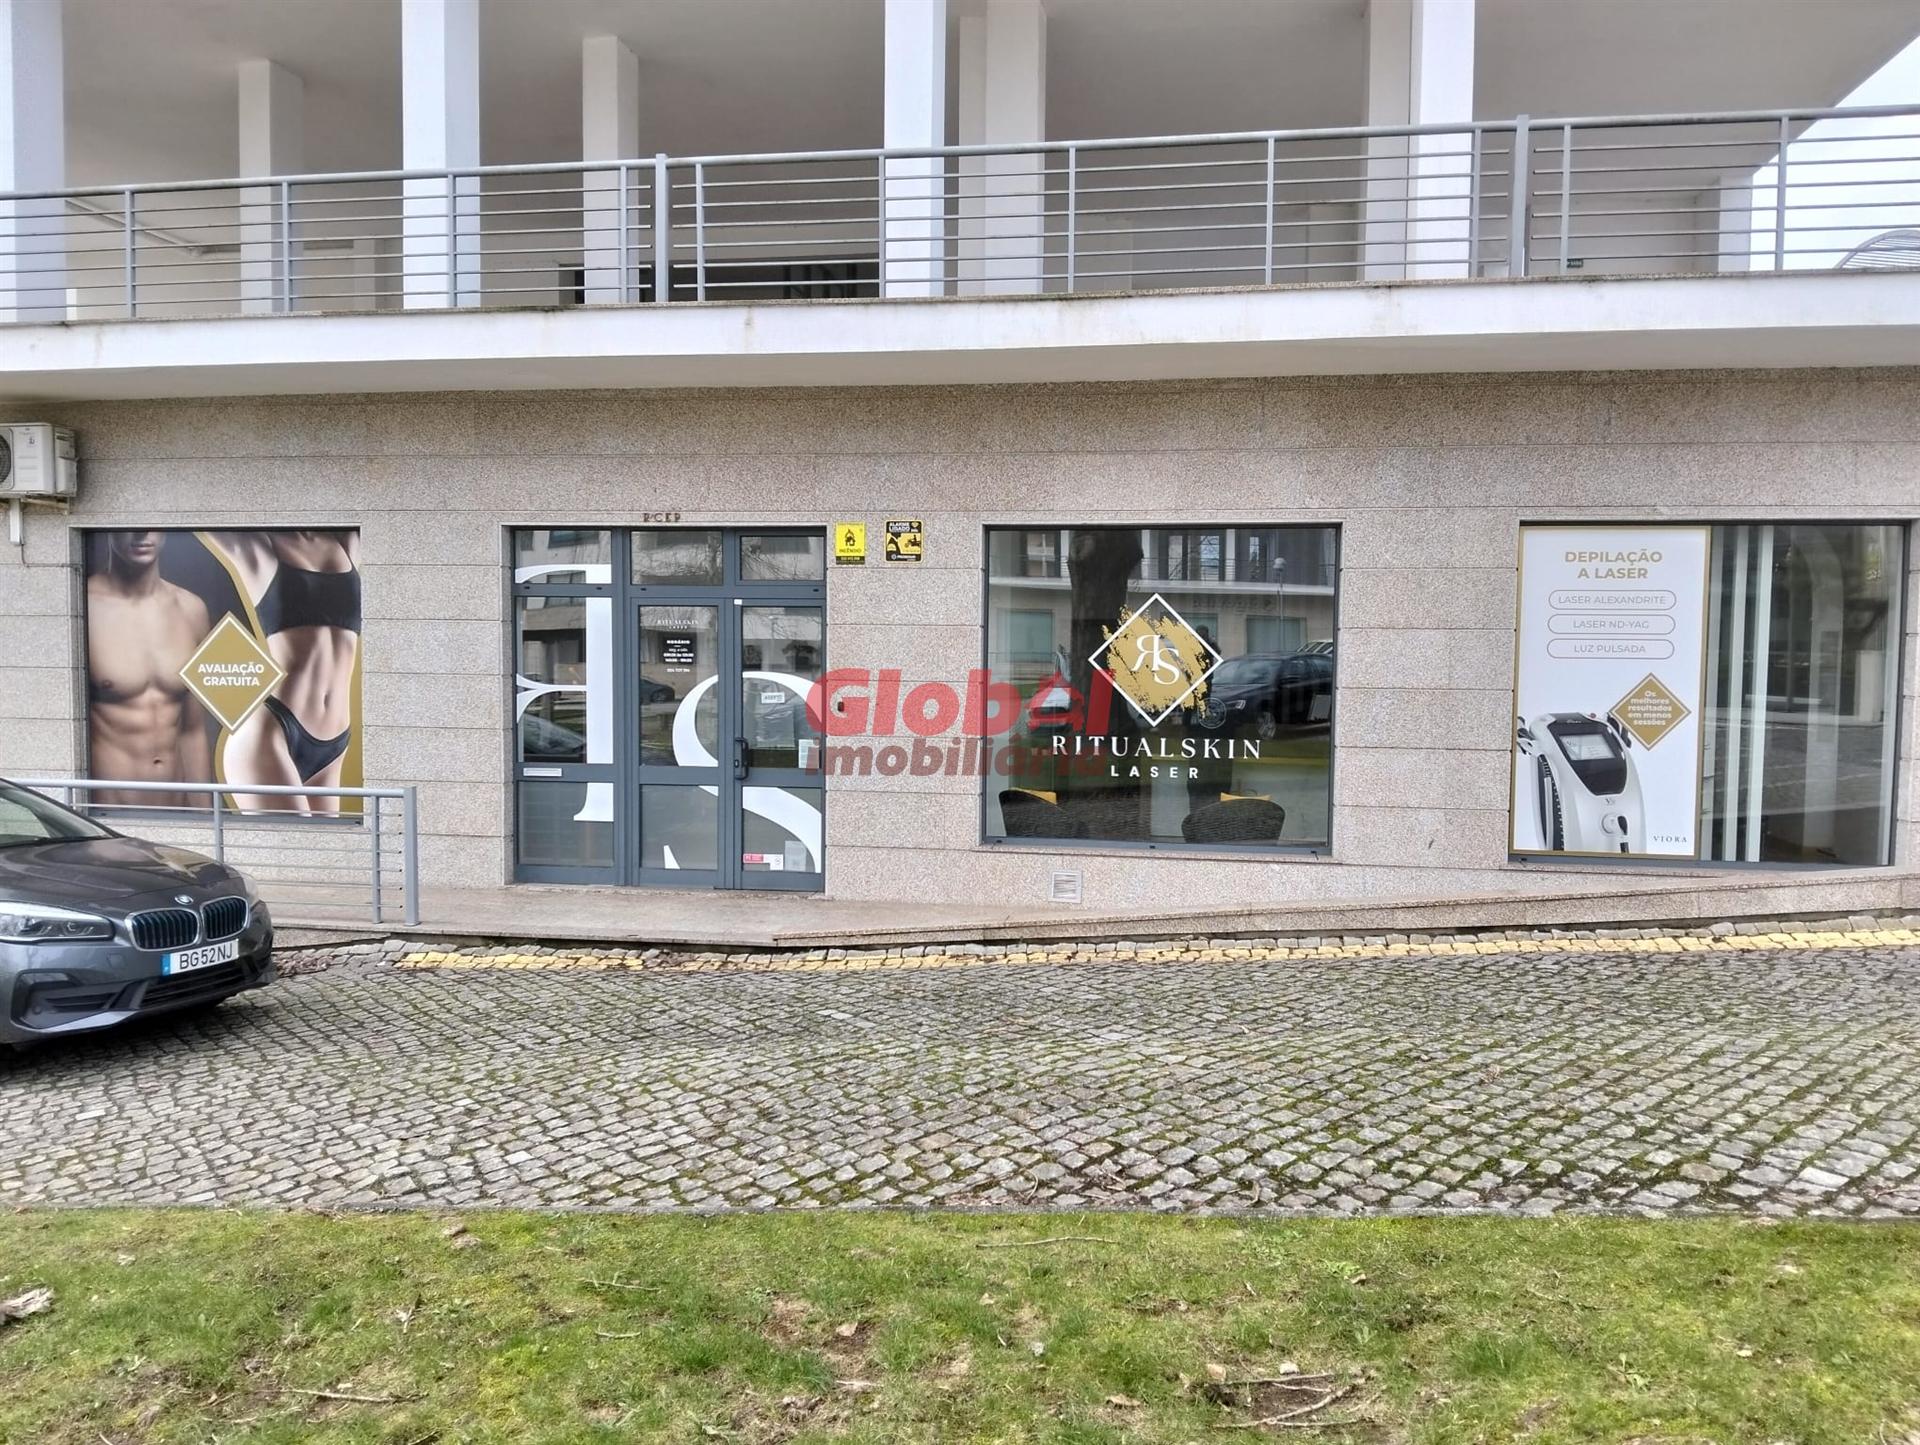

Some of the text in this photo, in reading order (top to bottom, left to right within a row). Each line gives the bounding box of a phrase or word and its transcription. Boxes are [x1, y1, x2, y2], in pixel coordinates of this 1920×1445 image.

[1565, 548, 1663, 566] DEPILAÇÃO
[1577, 568, 1649, 579] A LASER
[1558, 596, 1667, 605] LASER ALEXANDRITE
[1573, 620, 1650, 629] LASER ND-YAG
[1574, 645, 1647, 654] LUZ PULSADA
[198, 661, 264, 676] AVALIAÇÃO
[203, 676, 261, 687] GRATUITA
[1052, 735, 1261, 760] RITUALSKIN
[1110, 765, 1199, 779] LASER
[1653, 835, 1687, 843] VIORA
